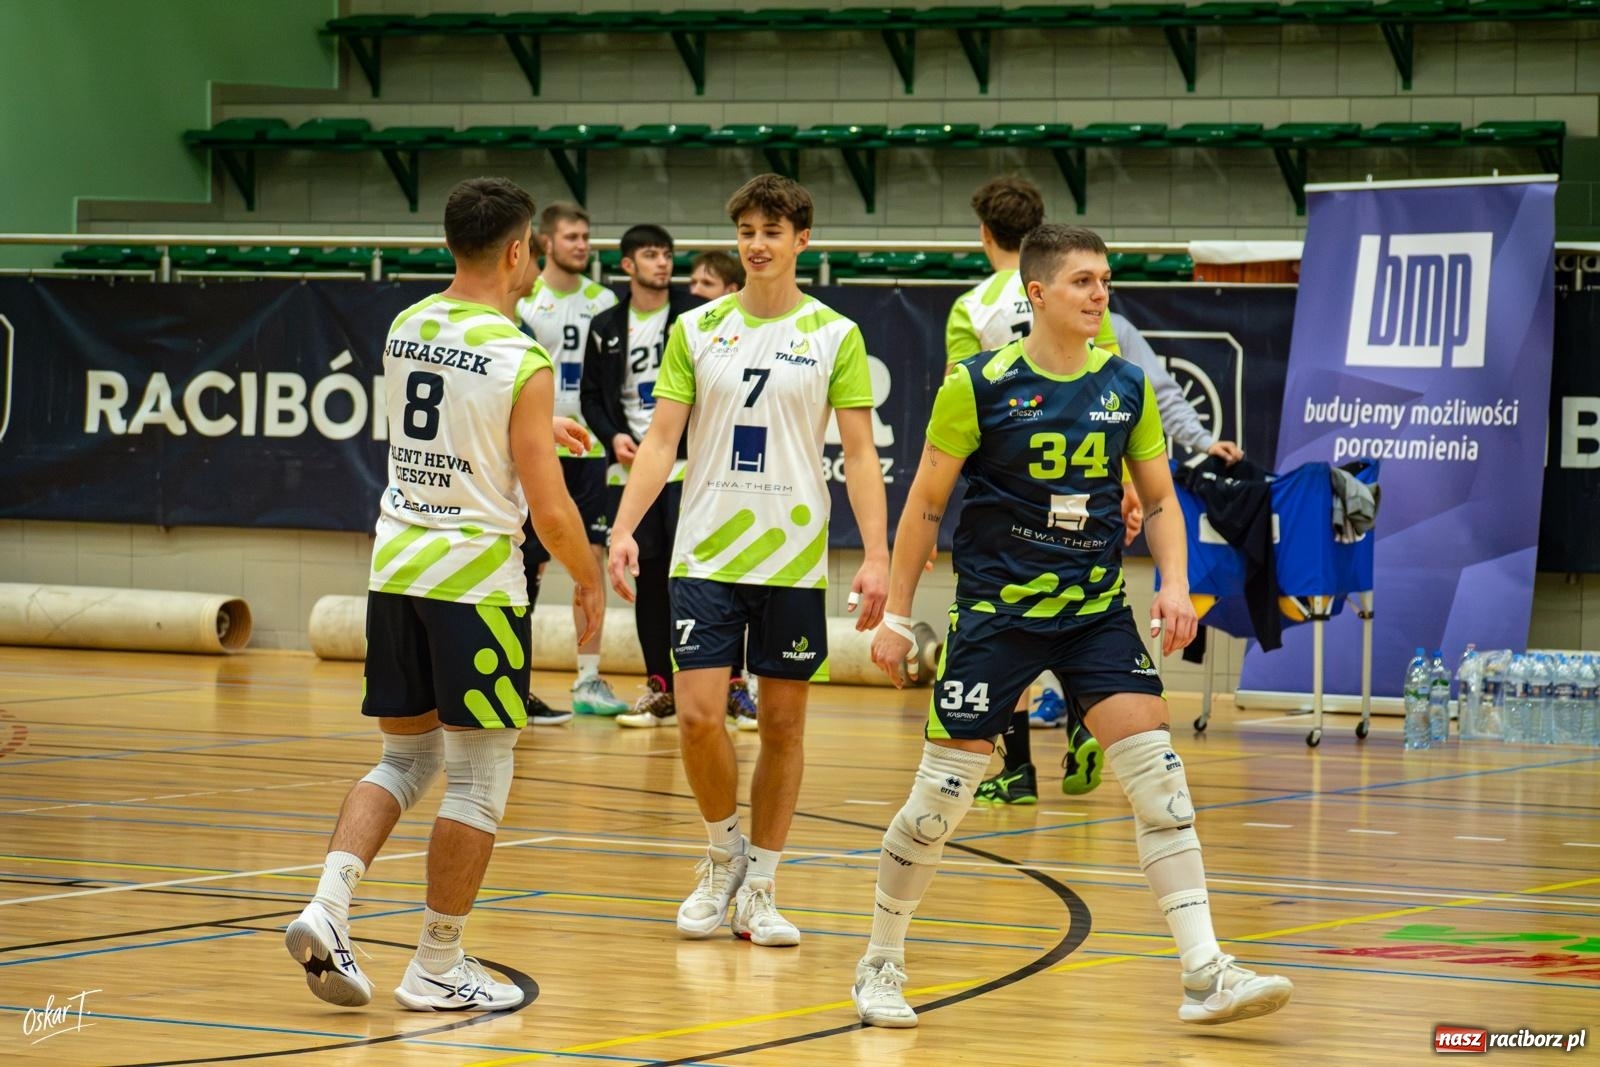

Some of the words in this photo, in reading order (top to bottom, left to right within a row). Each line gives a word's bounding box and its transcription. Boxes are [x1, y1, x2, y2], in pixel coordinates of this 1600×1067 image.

[1345, 232, 1493, 368] bmp
[563, 325, 579, 350] 9
[631, 342, 664, 374] 21
[775, 351, 818, 367] TALENT
[742, 367, 771, 408] 7
[403, 371, 445, 441] 8
[1089, 411, 1132, 422] TALENT
[1304, 396, 1405, 430] budujemy
[1410, 399, 1519, 426] możliwości
[391, 445, 422, 465] ALENT
[424, 454, 474, 475] HEWA
[1029, 432, 1109, 480] 34
[1333, 436, 1479, 462] porozumienia
[707, 480, 793, 493] HEWA-THERM
[1011, 524, 1108, 549] HEWA-THERM
[675, 619, 695, 645] 7
[782, 651, 816, 660] TALENT
[940, 680, 990, 712] 34
[946, 711, 979, 719] KASPRINT
[940, 785, 960, 798] errea
